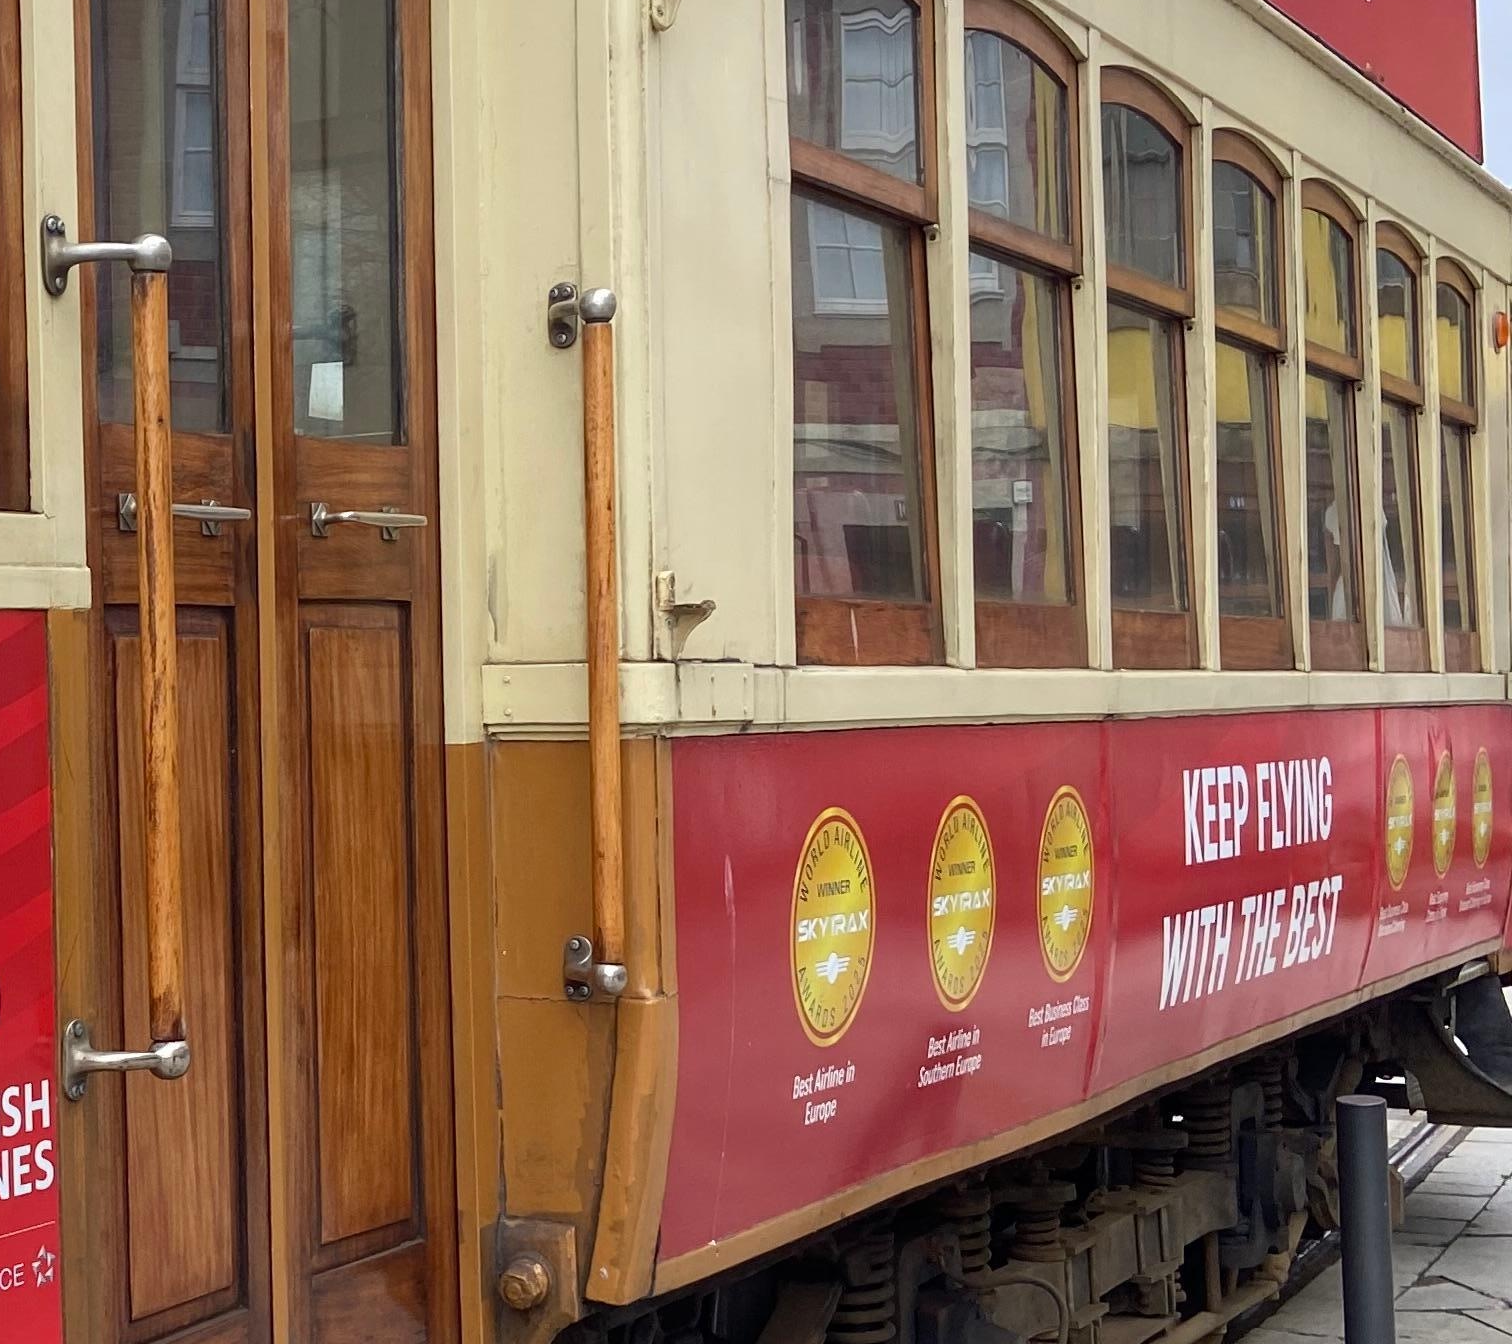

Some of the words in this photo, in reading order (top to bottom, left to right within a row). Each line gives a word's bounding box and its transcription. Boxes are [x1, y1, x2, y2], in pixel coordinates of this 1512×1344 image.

[1182, 764, 1249, 866] KEEP
[1255, 756, 1333, 852] FLYING
[799, 830, 830, 902] WORLD
[834, 826, 870, 893] AIRLINE
[947, 860, 976, 877] WINNER
[816, 879, 851, 898] WINNER
[1041, 869, 1091, 896] SKYTRAX
[932, 887, 992, 918] SKYTRAX
[797, 908, 870, 942] SKYTRAX
[1158, 901, 1234, 1011] WITH
[1234, 888, 1286, 985] THE
[1282, 874, 1343, 969] BEST
[798, 966, 836, 1028] AWARDS
[1029, 1006, 1044, 1028] Best
[1044, 1000, 1072, 1024] Business
[1072, 995, 1090, 1015] Class
[927, 1035, 947, 1059] Best
[946, 1028, 972, 1053] Airline
[971, 1024, 980, 1046] in
[1049, 1025, 1072, 1046] Europe
[792, 1073, 814, 1100] Best
[814, 1065, 845, 1093] Airline
[845, 1059, 856, 1083] in
[917, 1062, 955, 1088] Southern
[955, 1054, 982, 1076] Europe
[804, 1099, 837, 1126] Europe
